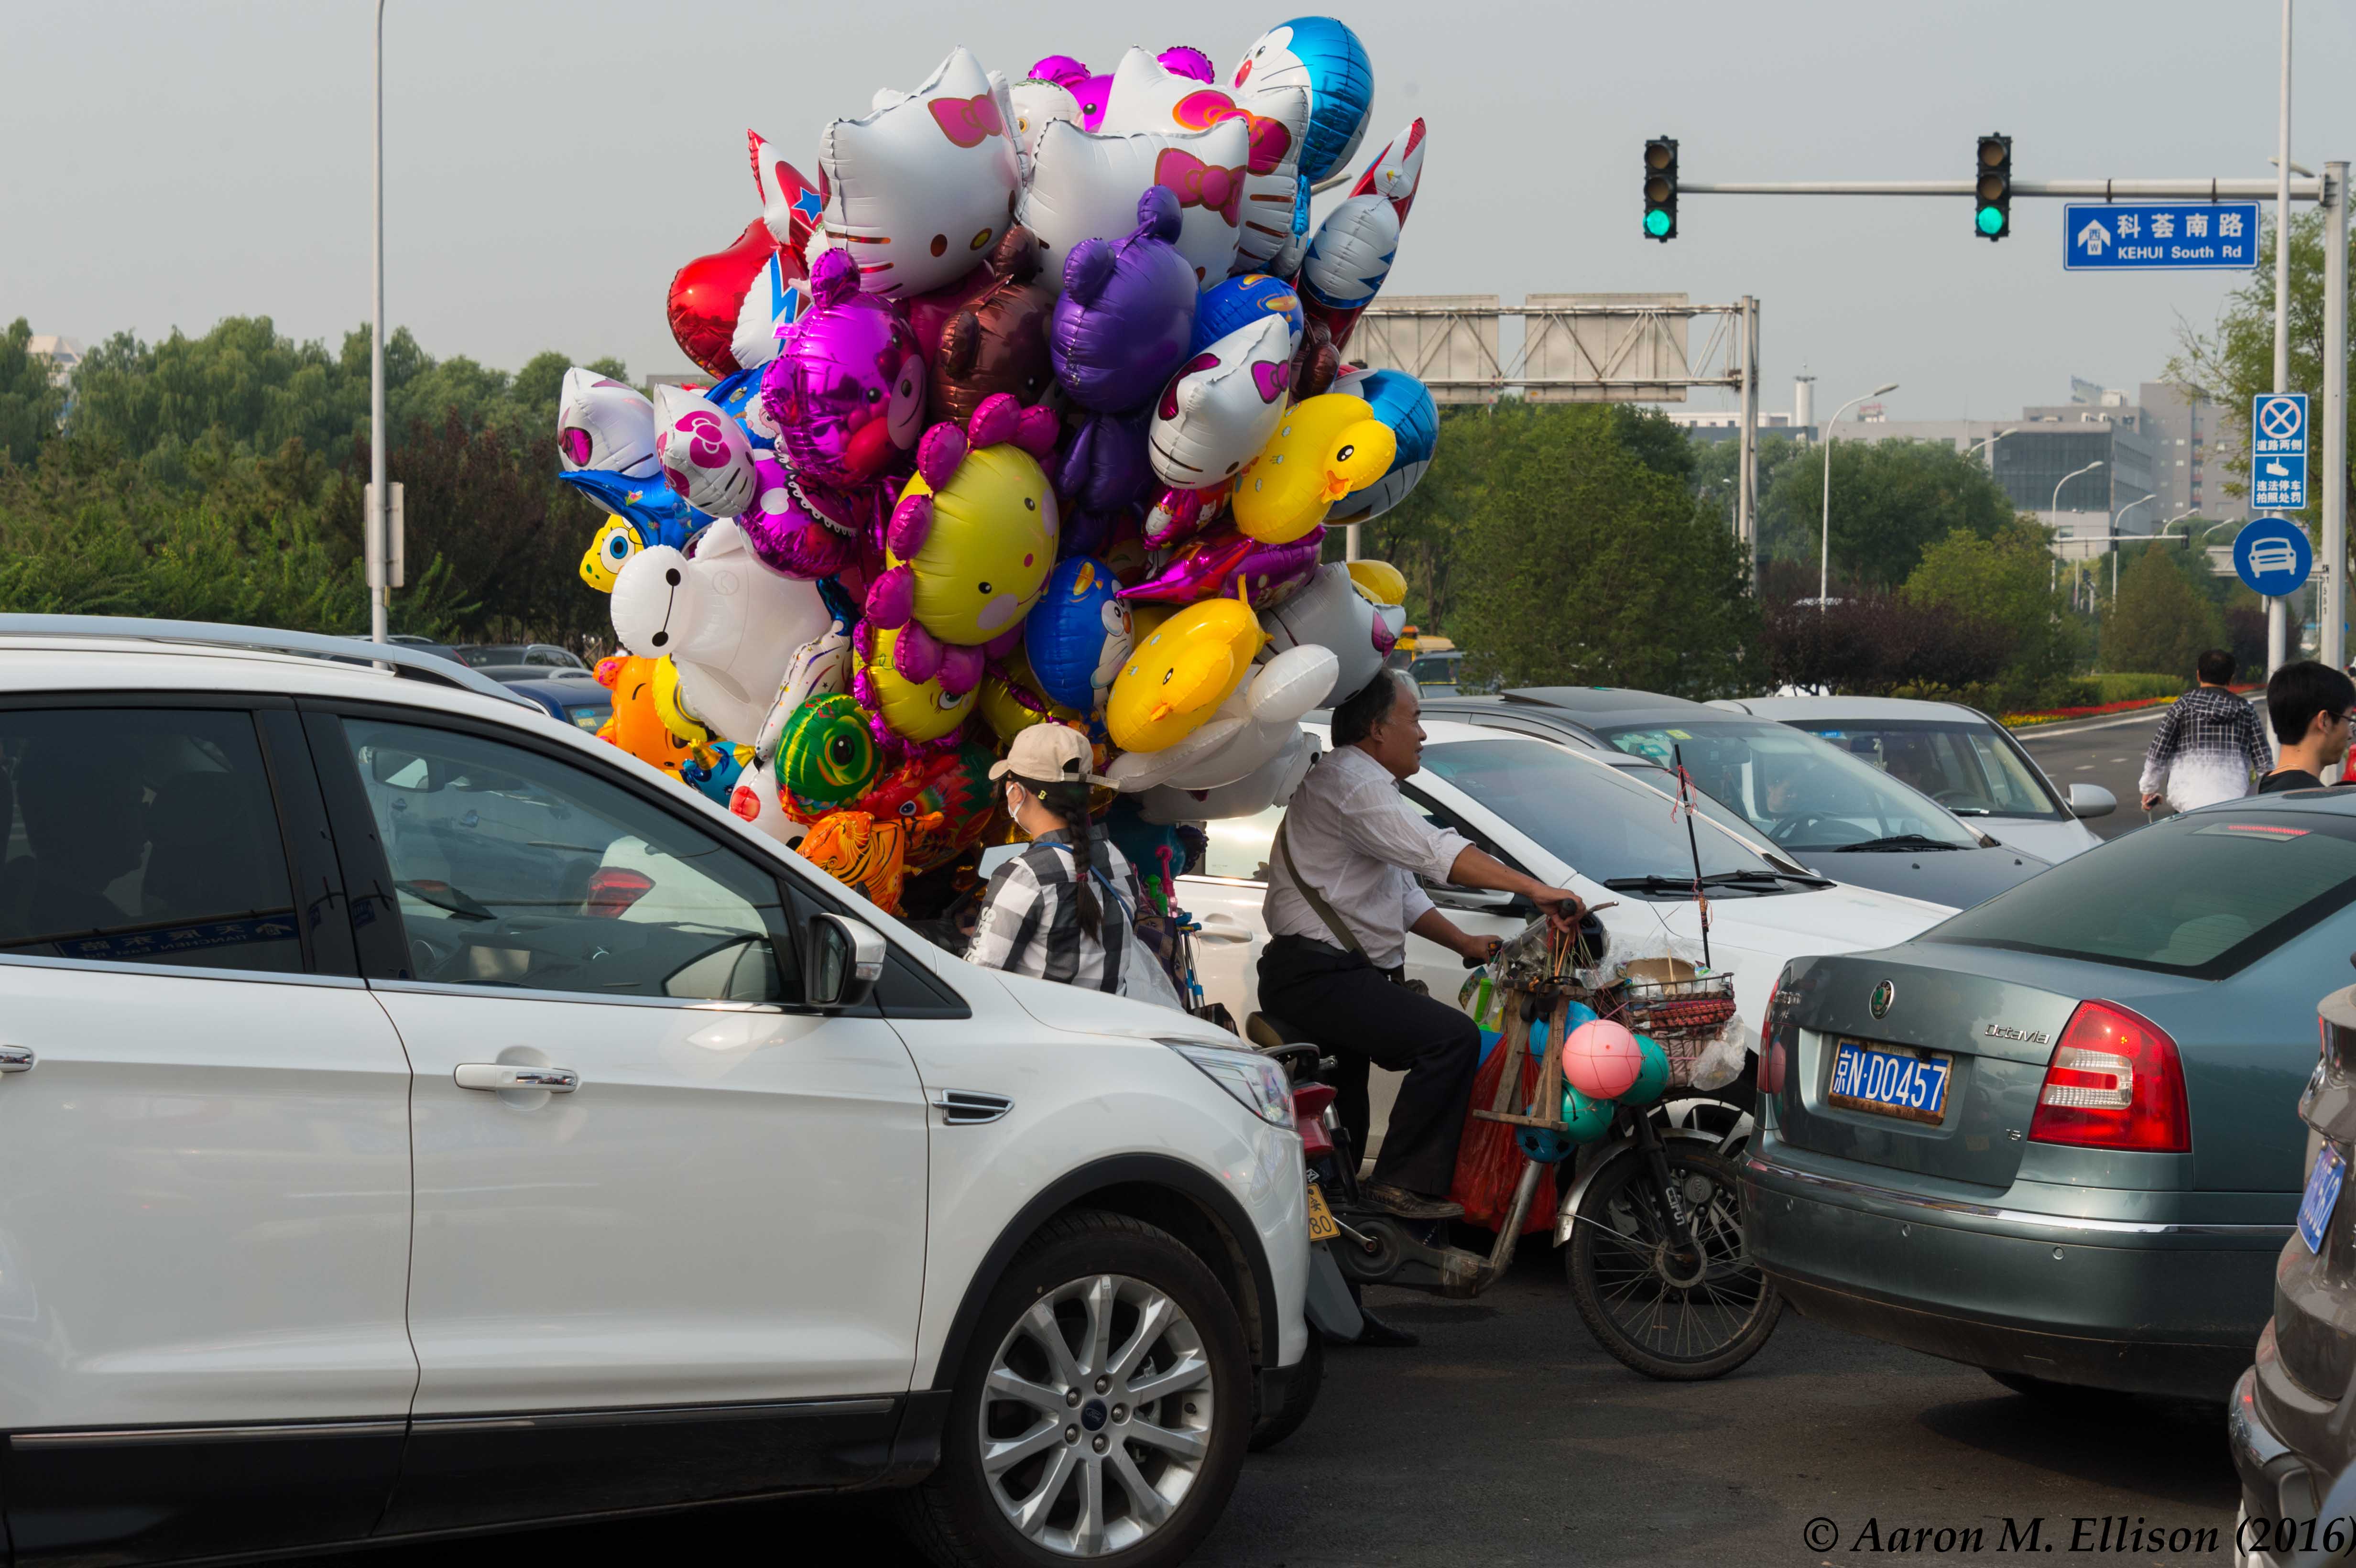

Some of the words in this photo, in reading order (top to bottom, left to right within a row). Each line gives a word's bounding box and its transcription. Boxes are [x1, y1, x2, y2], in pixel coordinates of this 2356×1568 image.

[2117, 213, 2243, 239] 科荟南路
[2090, 244, 2099, 252] W
[2118, 246, 2163, 259] KEHUI
[2171, 246, 2214, 259] South
[2222, 245, 2242, 258] Rd
[2257, 439, 2302, 451] 道路两侧
[2257, 479, 2301, 492] 违法停车
[2256, 491, 2301, 503] 拍照处罚
[1985, 1024, 2051, 1045] Octavia
